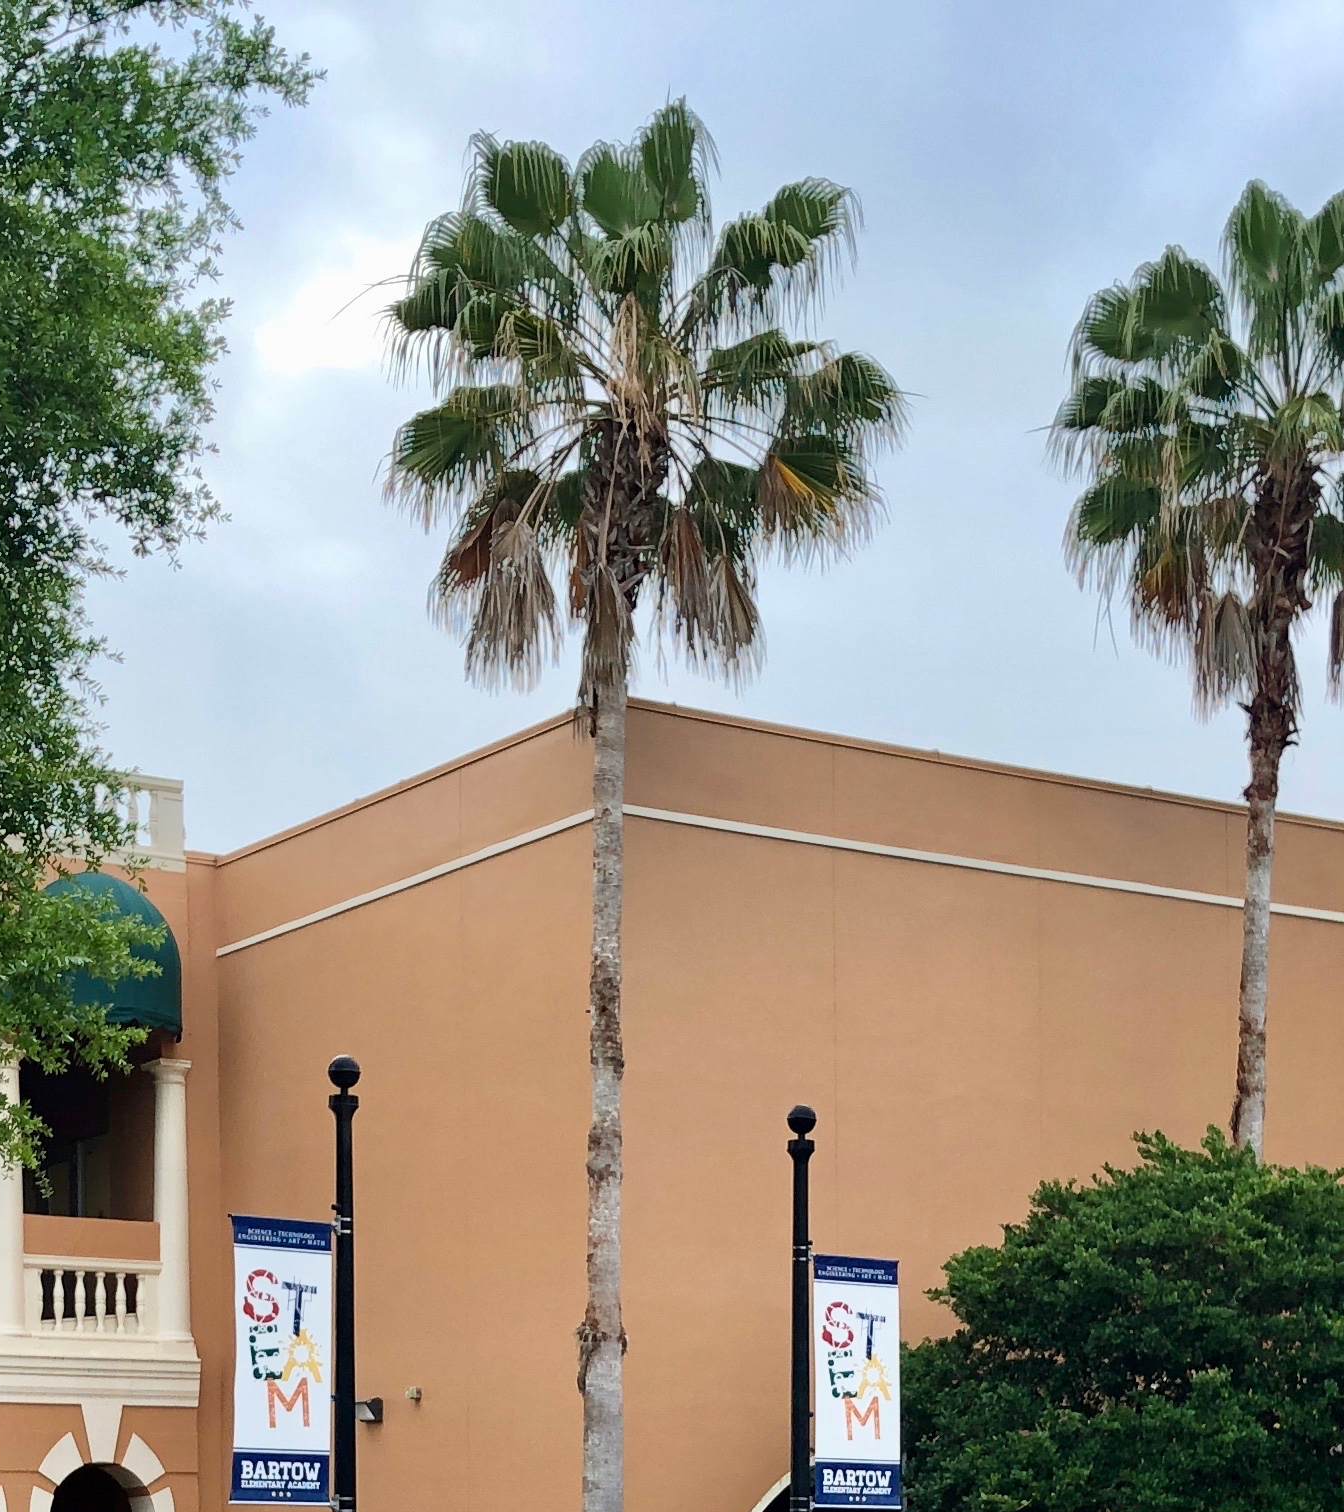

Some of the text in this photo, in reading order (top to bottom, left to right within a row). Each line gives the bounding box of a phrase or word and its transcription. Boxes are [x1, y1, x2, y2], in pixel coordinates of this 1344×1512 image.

[241, 1459, 321, 1481] BARTOW
[822, 1468, 892, 1487] BARTOW
[241, 1480, 321, 1490] ELEMENTARY ACADEMY
